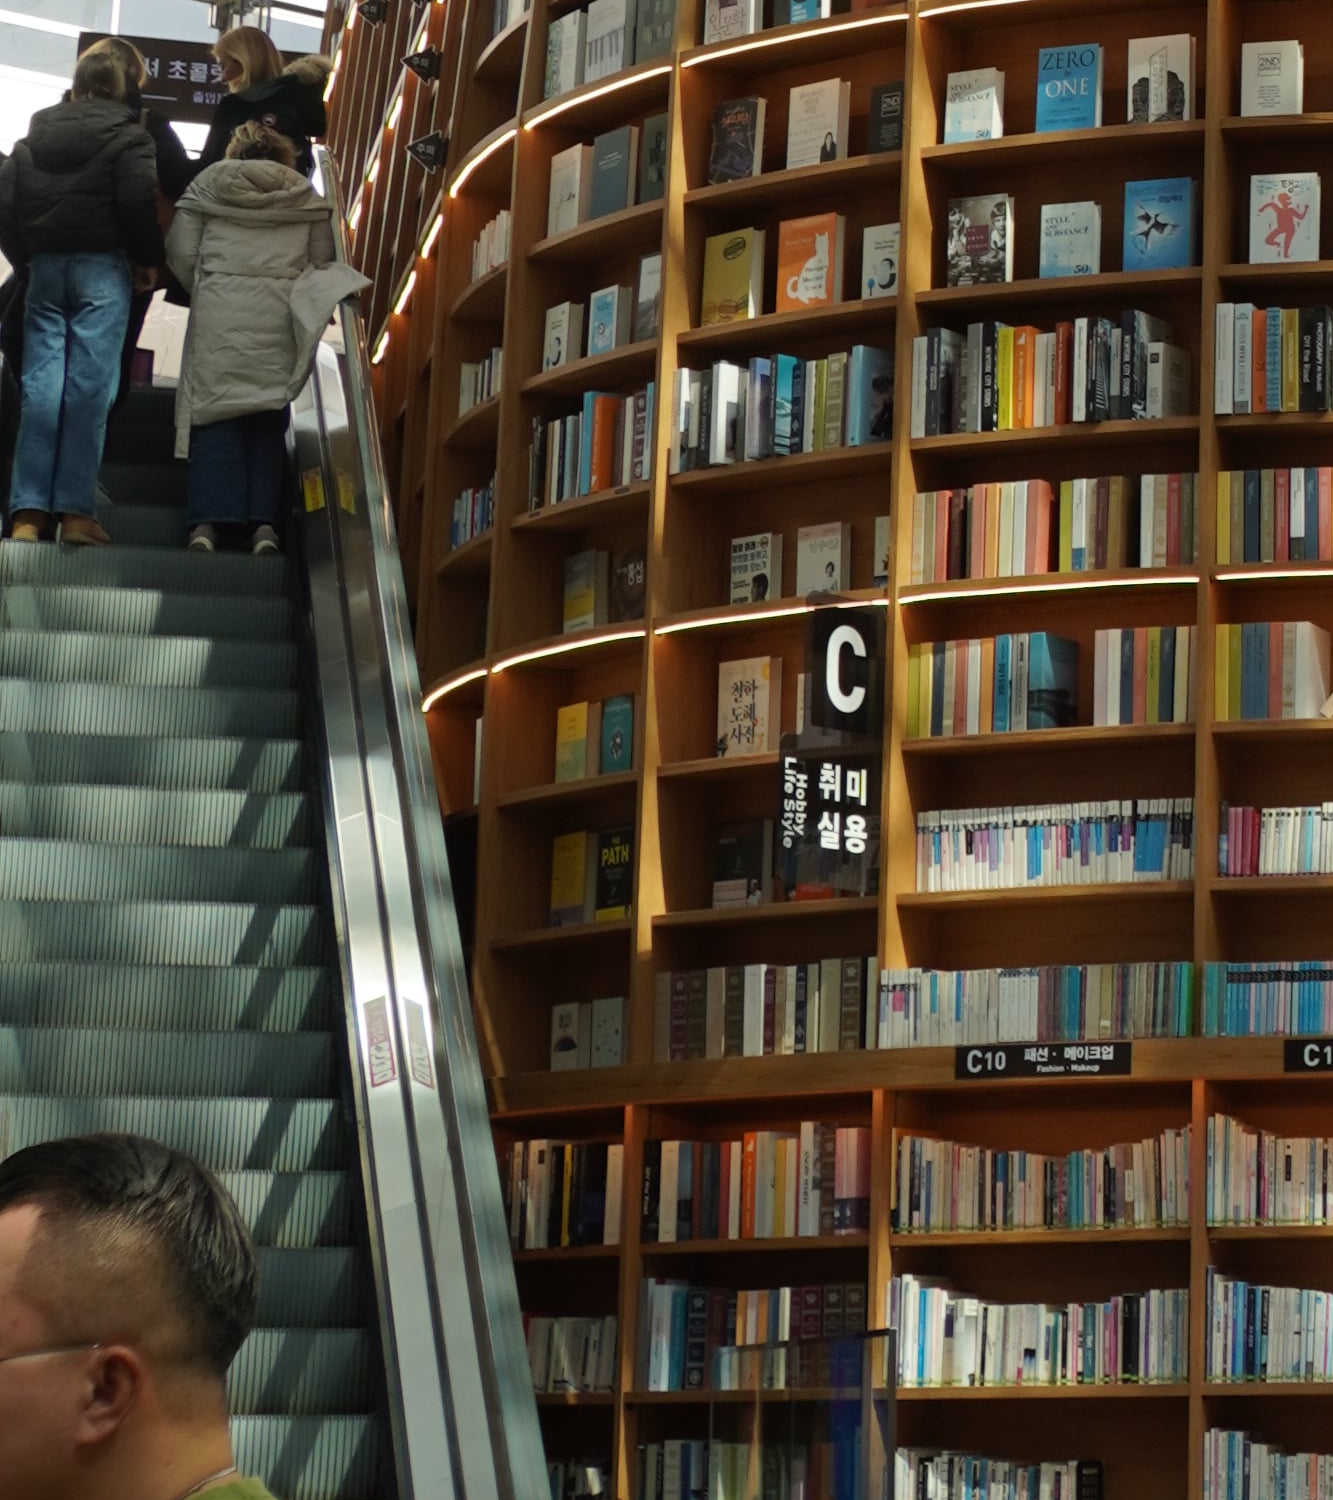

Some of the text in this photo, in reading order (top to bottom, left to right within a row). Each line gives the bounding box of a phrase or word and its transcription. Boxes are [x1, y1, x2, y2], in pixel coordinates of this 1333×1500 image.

[1042, 49, 1096, 70] ZERO
[1259, 57, 1280, 66] 2ND
[951, 84, 974, 92] STYLE
[1045, 78, 1089, 98] ONE
[1045, 215, 1069, 223] STYLE
[1044, 227, 1090, 237] SUBSTANCE
[1123, 363, 1131, 376] CITY
[826, 625, 867, 713] C
[818, 762, 867, 806] 취미
[781, 756, 797, 849] Life Style
[793, 774, 808, 836] Hobby
[817, 811, 868, 854] 실용
[601, 844, 629, 866] PATH
[967, 1049, 1006, 1073] C10
[1024, 1045, 1114, 1063] 패션 메이크업
[1037, 1063, 1100, 1073] Fashion Makeup
